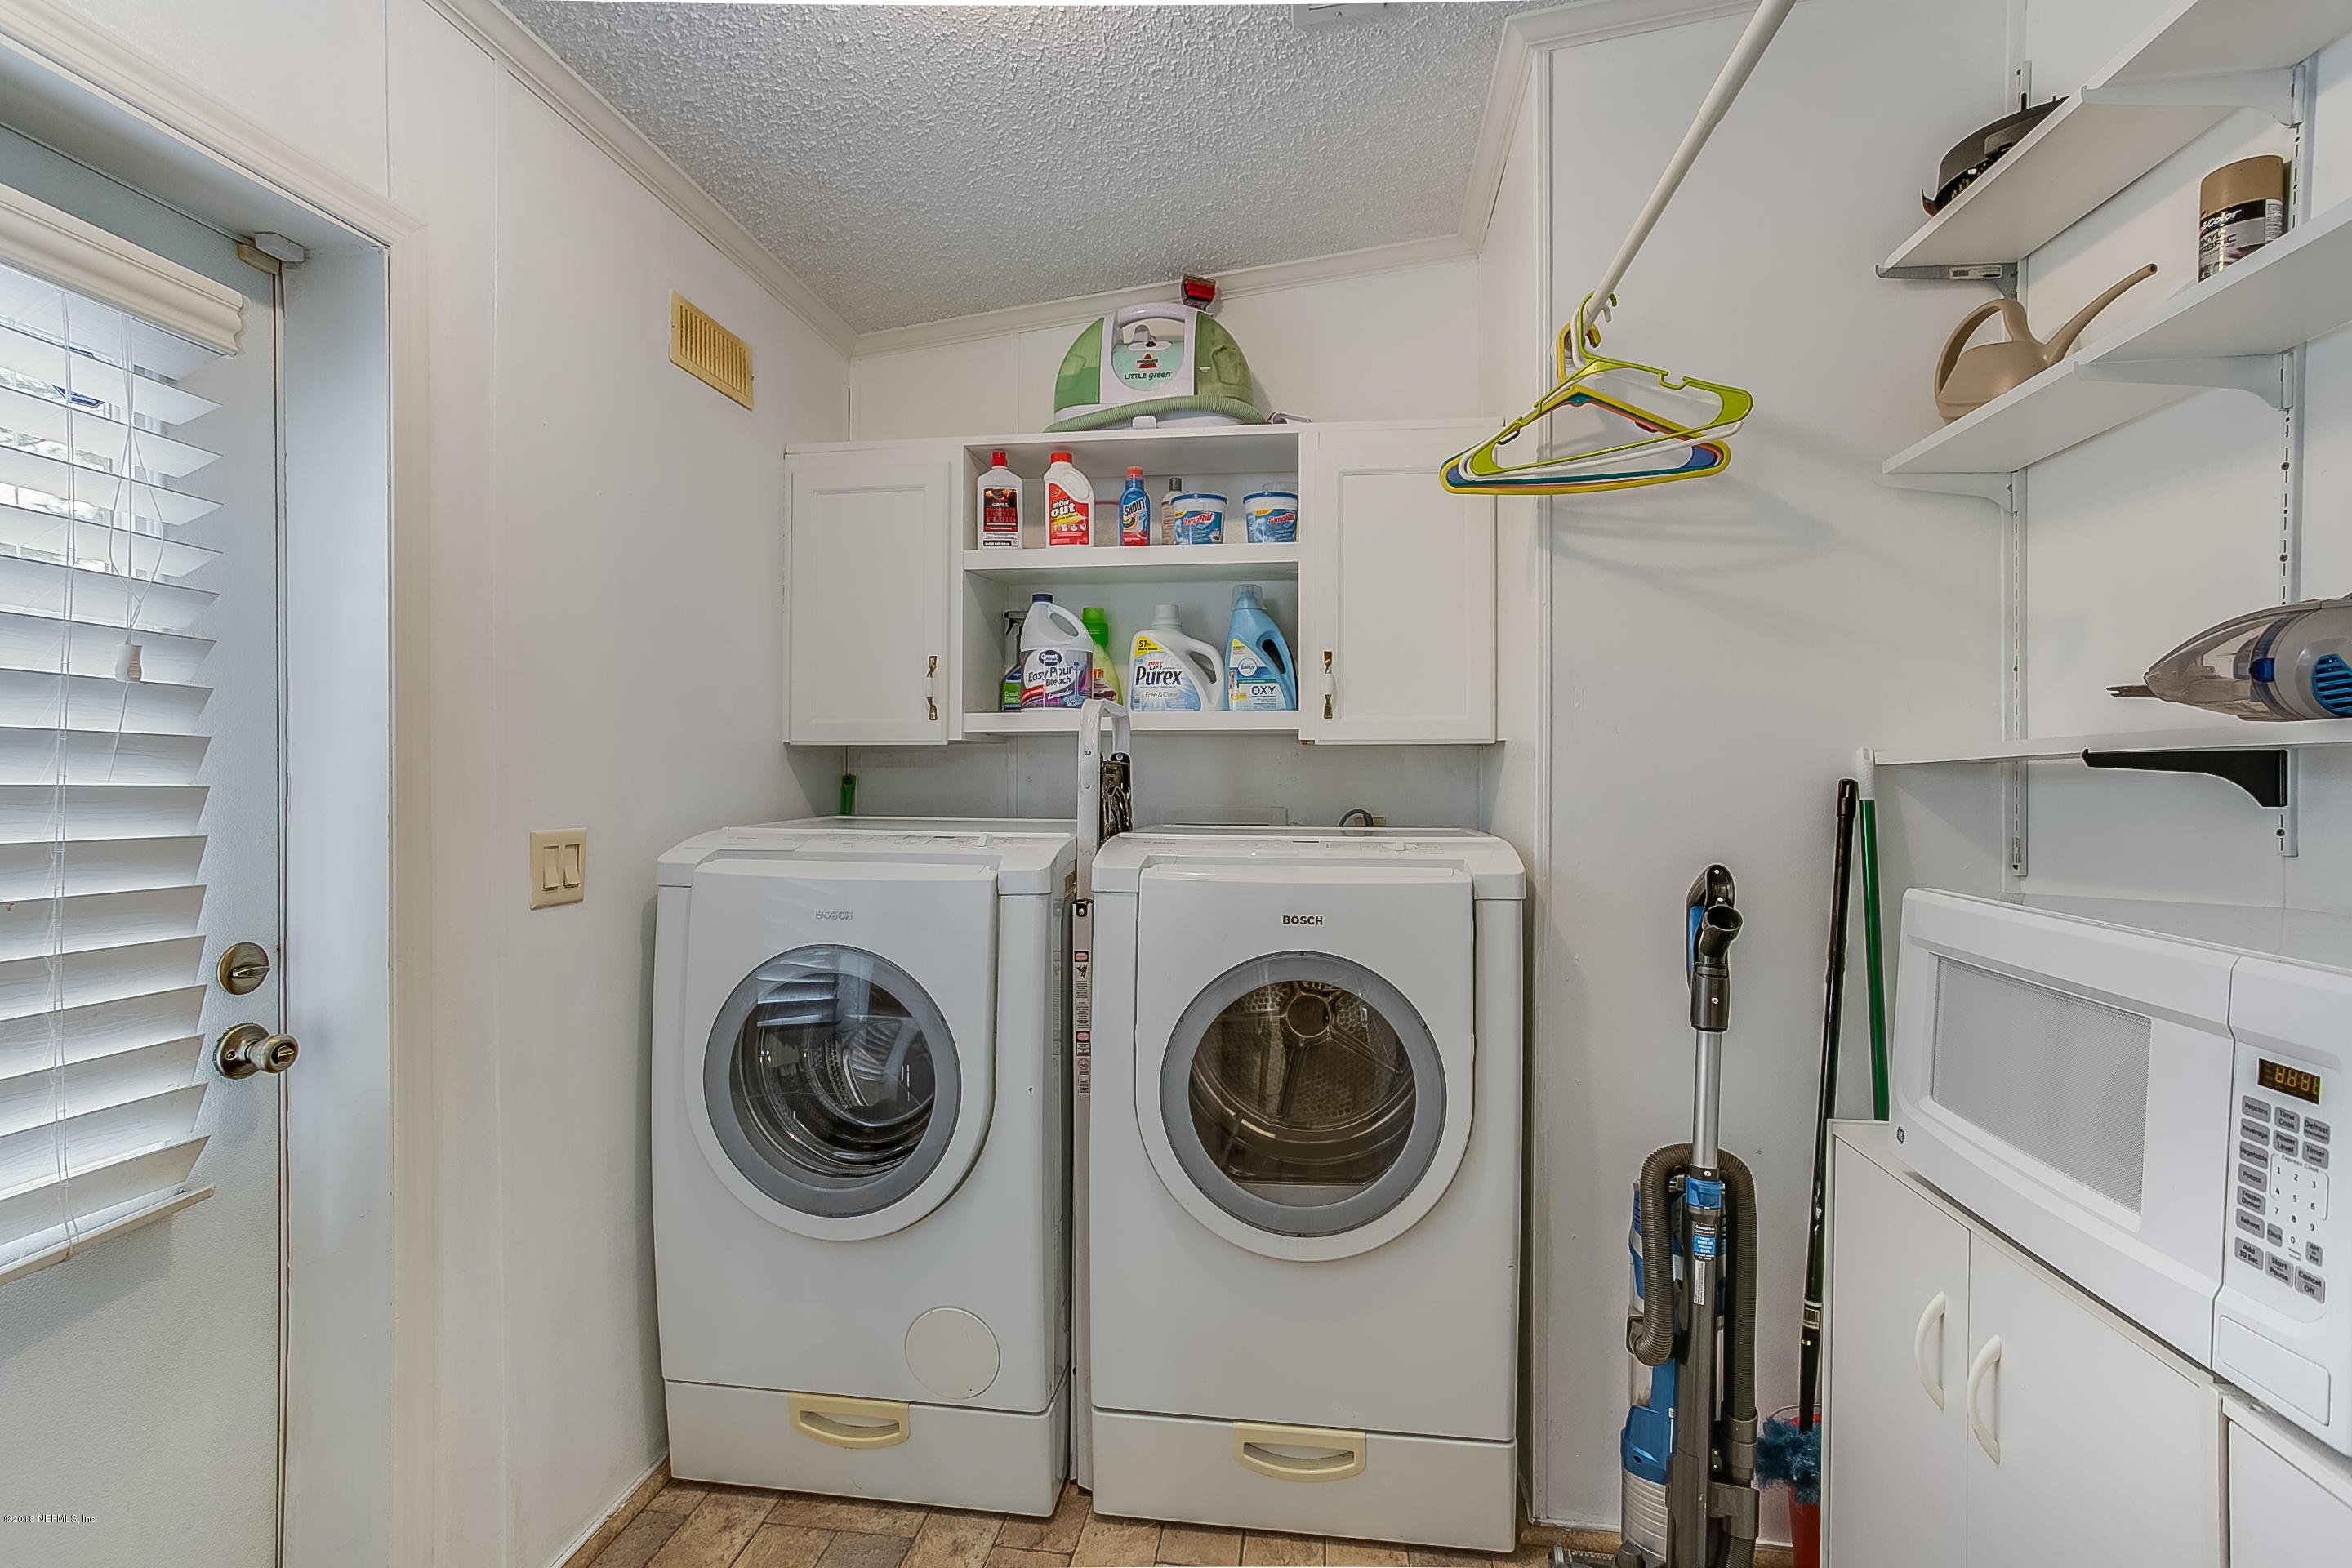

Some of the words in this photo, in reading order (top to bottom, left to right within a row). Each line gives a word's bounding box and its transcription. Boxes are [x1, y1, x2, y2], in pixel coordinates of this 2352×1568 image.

[1148, 372, 1171, 381] green
[1124, 497, 1145, 517] SHOUT
[1183, 512, 1214, 526] DampRid
[1267, 512, 1296, 525] DampRid
[1040, 653, 1059, 661] Great
[1027, 668, 1048, 683] Easy
[1049, 666, 1074, 678] Pour
[1135, 666, 1183, 686] Purex
[1045, 676, 1071, 687] Bleach
[1047, 689, 1073, 700] Lavender
[1251, 685, 1276, 696] OXY
[1282, 915, 1323, 925] BOSCH
[2244, 1102, 2268, 1116] Popcorn
[2279, 1109, 2295, 1120] Time
[2278, 1118, 2295, 1129] Cook
[2304, 1120, 2329, 1134] Defrost
[2242, 1124, 2269, 1139] Beverage
[2276, 1133, 2296, 1145] Power
[2239, 1145, 2268, 1163] Vegetable
[2277, 1142, 2294, 1153] Level
[2306, 1145, 2325, 1157] Timer
[2281, 1154, 2303, 1167] Express
[2243, 1170, 2262, 1184] Potato
[2277, 1166, 2281, 1174] 1
[2293, 1173, 2299, 1182] 2
[2312, 1180, 2317, 1189] 3
[2242, 1189, 2261, 1203] Frozen
[2274, 1187, 2280, 1195] 4
[2292, 1194, 2297, 1203] 5
[2310, 1202, 2316, 1211] 6
[2241, 1196, 2261, 1210] Dinner
[2240, 1215, 2261, 1231] Reheat
[2274, 1206, 2279, 1215] 7
[2291, 1214, 2296, 1223] 8
[2310, 1223, 2315, 1232] 9
[2267, 1229, 2283, 1242] Clock
[2243, 1244, 2255, 1255] Add
[2310, 1244, 2319, 1252] AM
[2247, 1254, 2258, 1266] Sec
[2271, 1256, 2287, 1270] Start
[2309, 1254, 2319, 1263] PM
[2270, 1266, 2288, 1281] Pause
[2298, 1270, 2322, 1288] Cancel
[2304, 1285, 2315, 1295] Off
